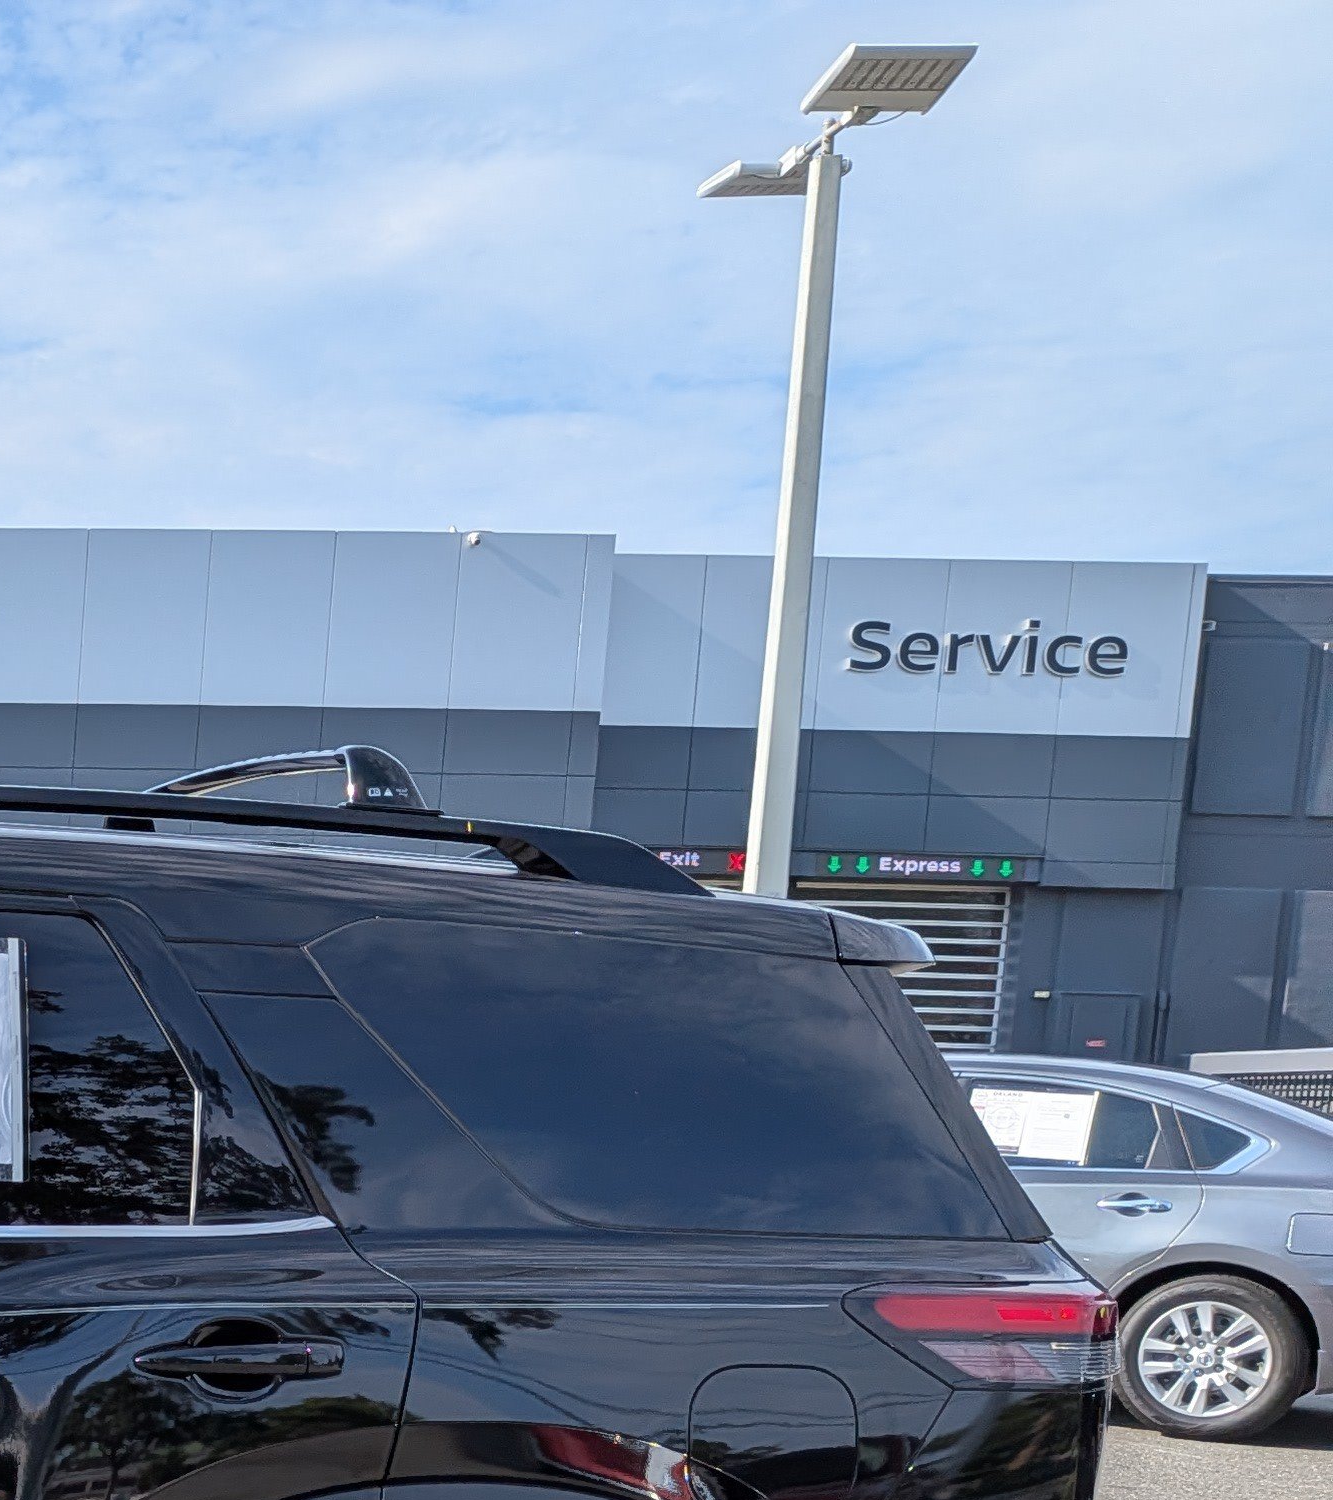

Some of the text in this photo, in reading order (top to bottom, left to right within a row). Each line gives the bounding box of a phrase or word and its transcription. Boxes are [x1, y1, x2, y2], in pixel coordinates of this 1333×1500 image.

[846, 619, 1130, 678] Service
[658, 851, 701, 867] Exit
[878, 856, 961, 876] Express
